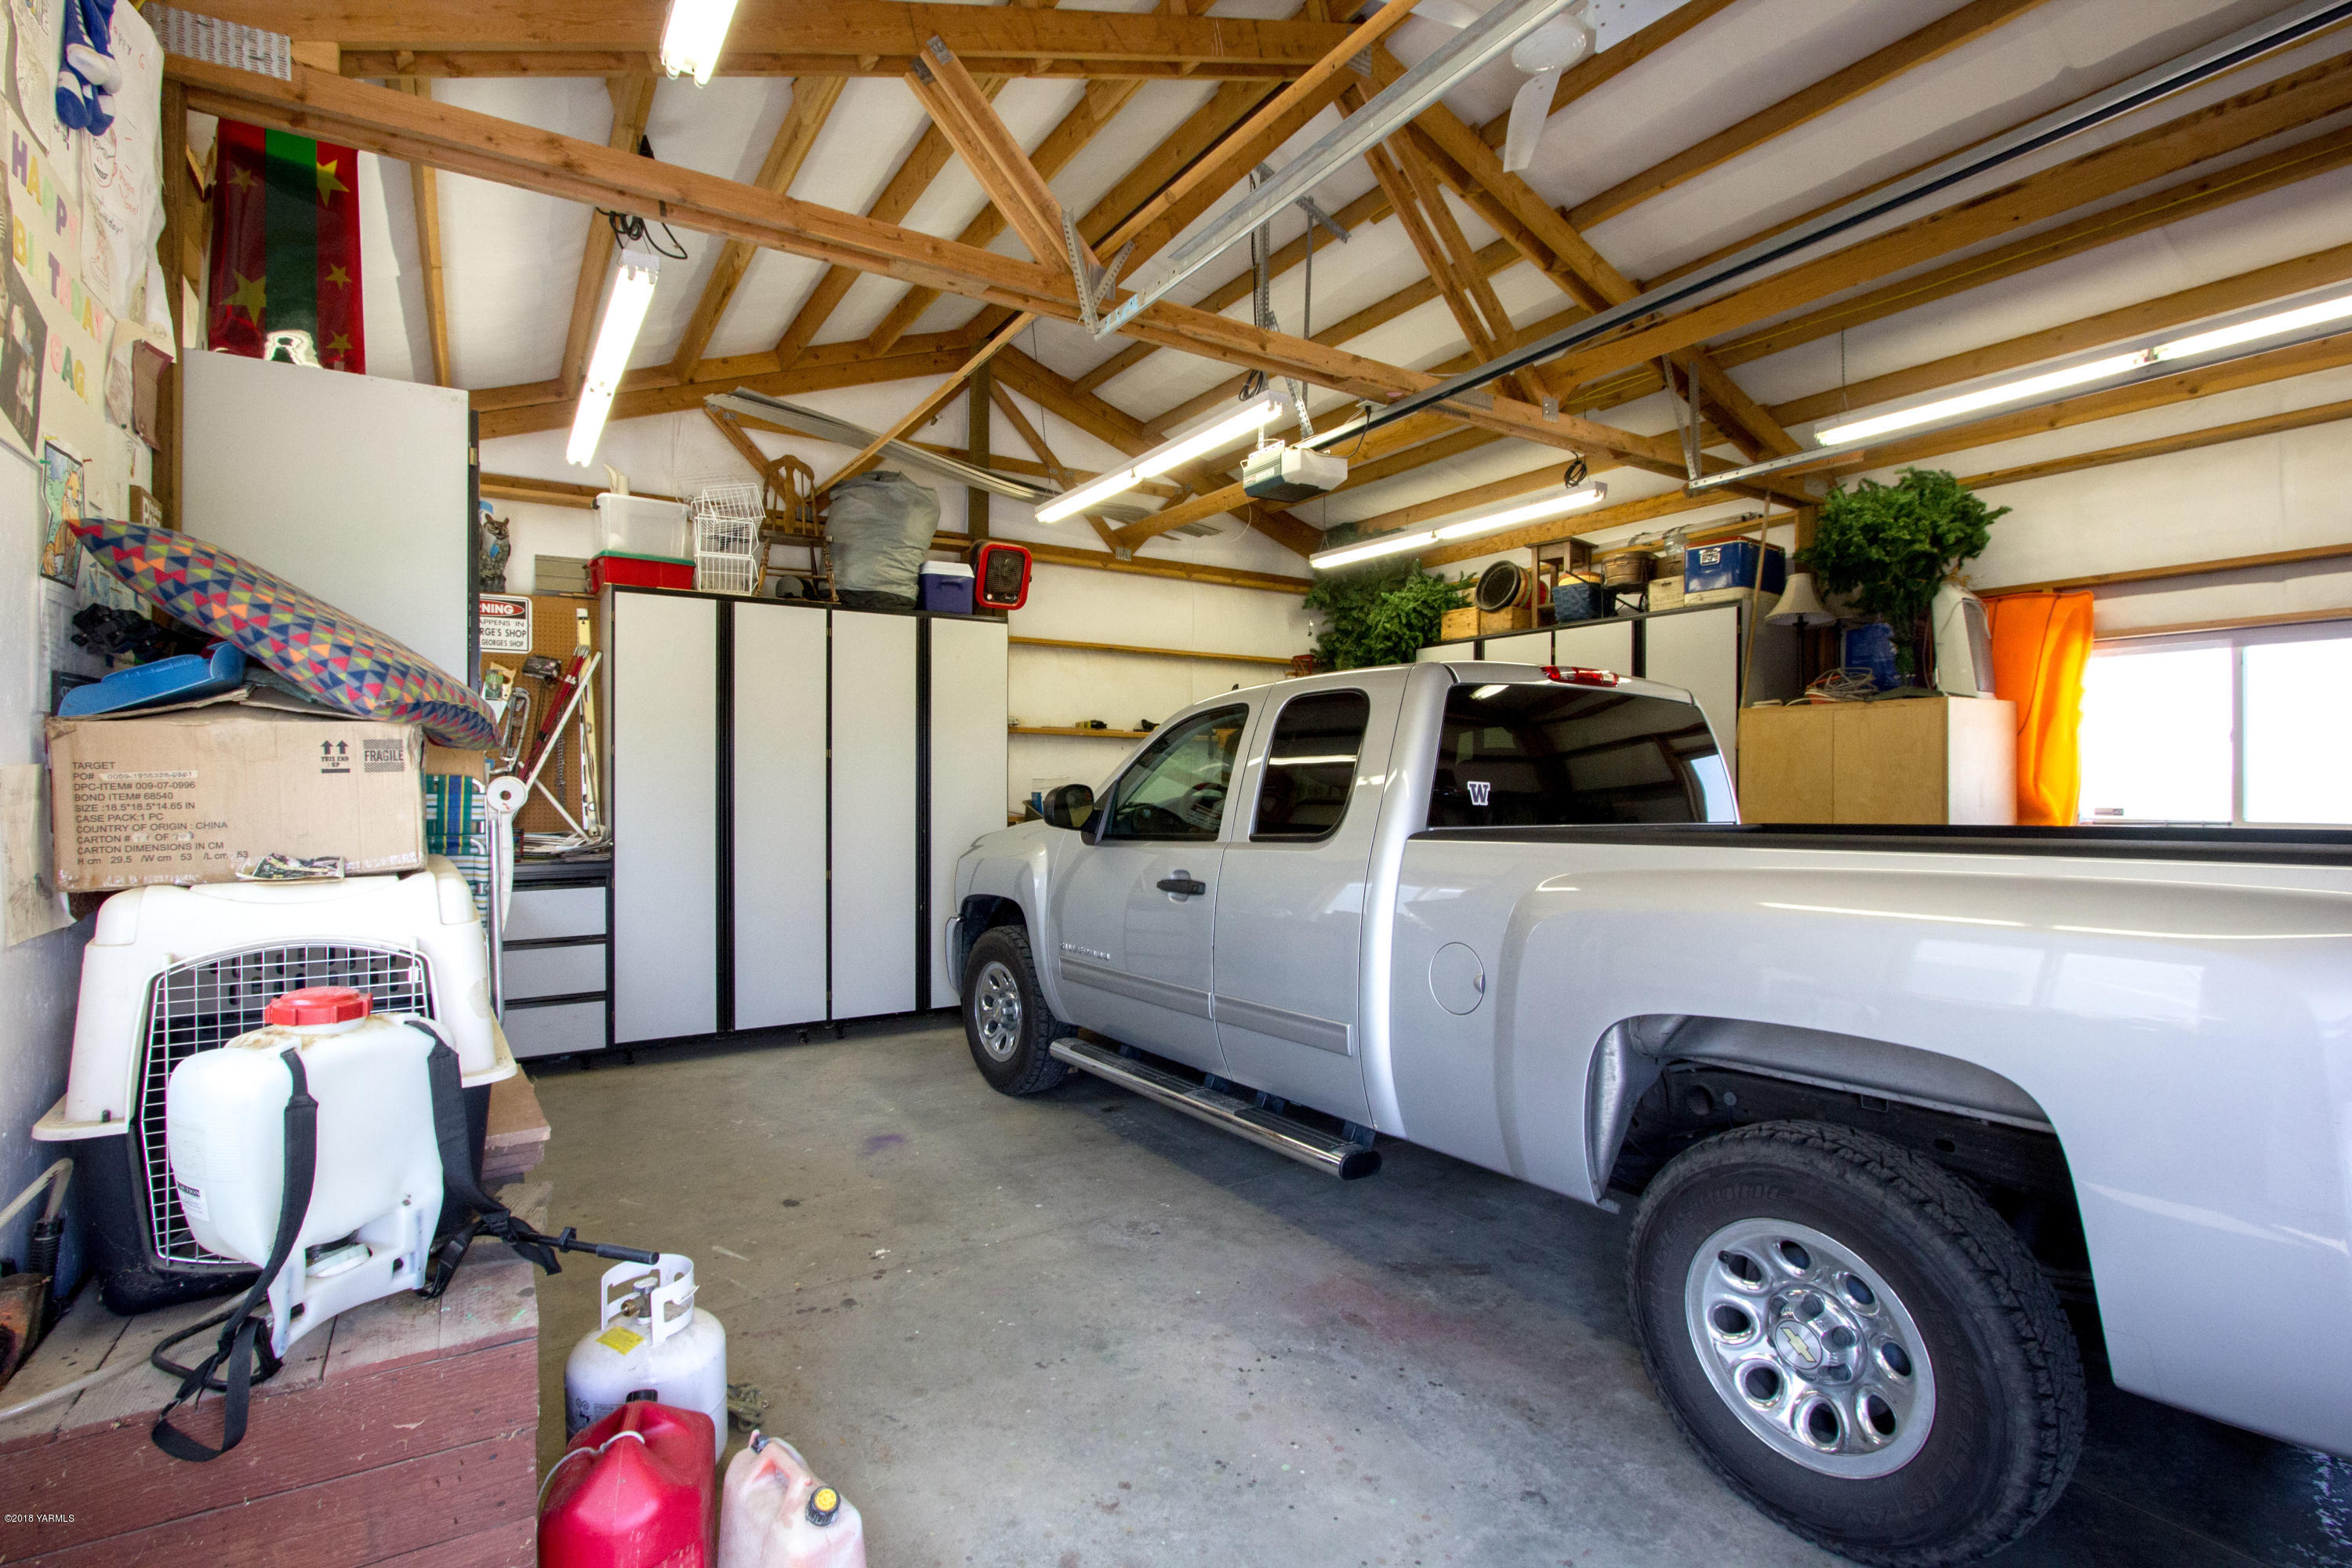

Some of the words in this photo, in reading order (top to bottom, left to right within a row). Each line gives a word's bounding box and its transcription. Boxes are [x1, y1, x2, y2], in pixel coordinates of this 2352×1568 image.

[12, 130, 78, 251] HAPPY
[13, 215, 103, 343] BIRTHDAY
[480, 604, 514, 614] NING
[365, 750, 404, 761] FRAGILE
[74, 782, 132, 791] DPC-ITEM#
[1468, 782, 1490, 805] W
[77, 825, 129, 833] COUNTRY
[78, 846, 122, 855] CARTON
[125, 844, 192, 853] DIMENSIONS
